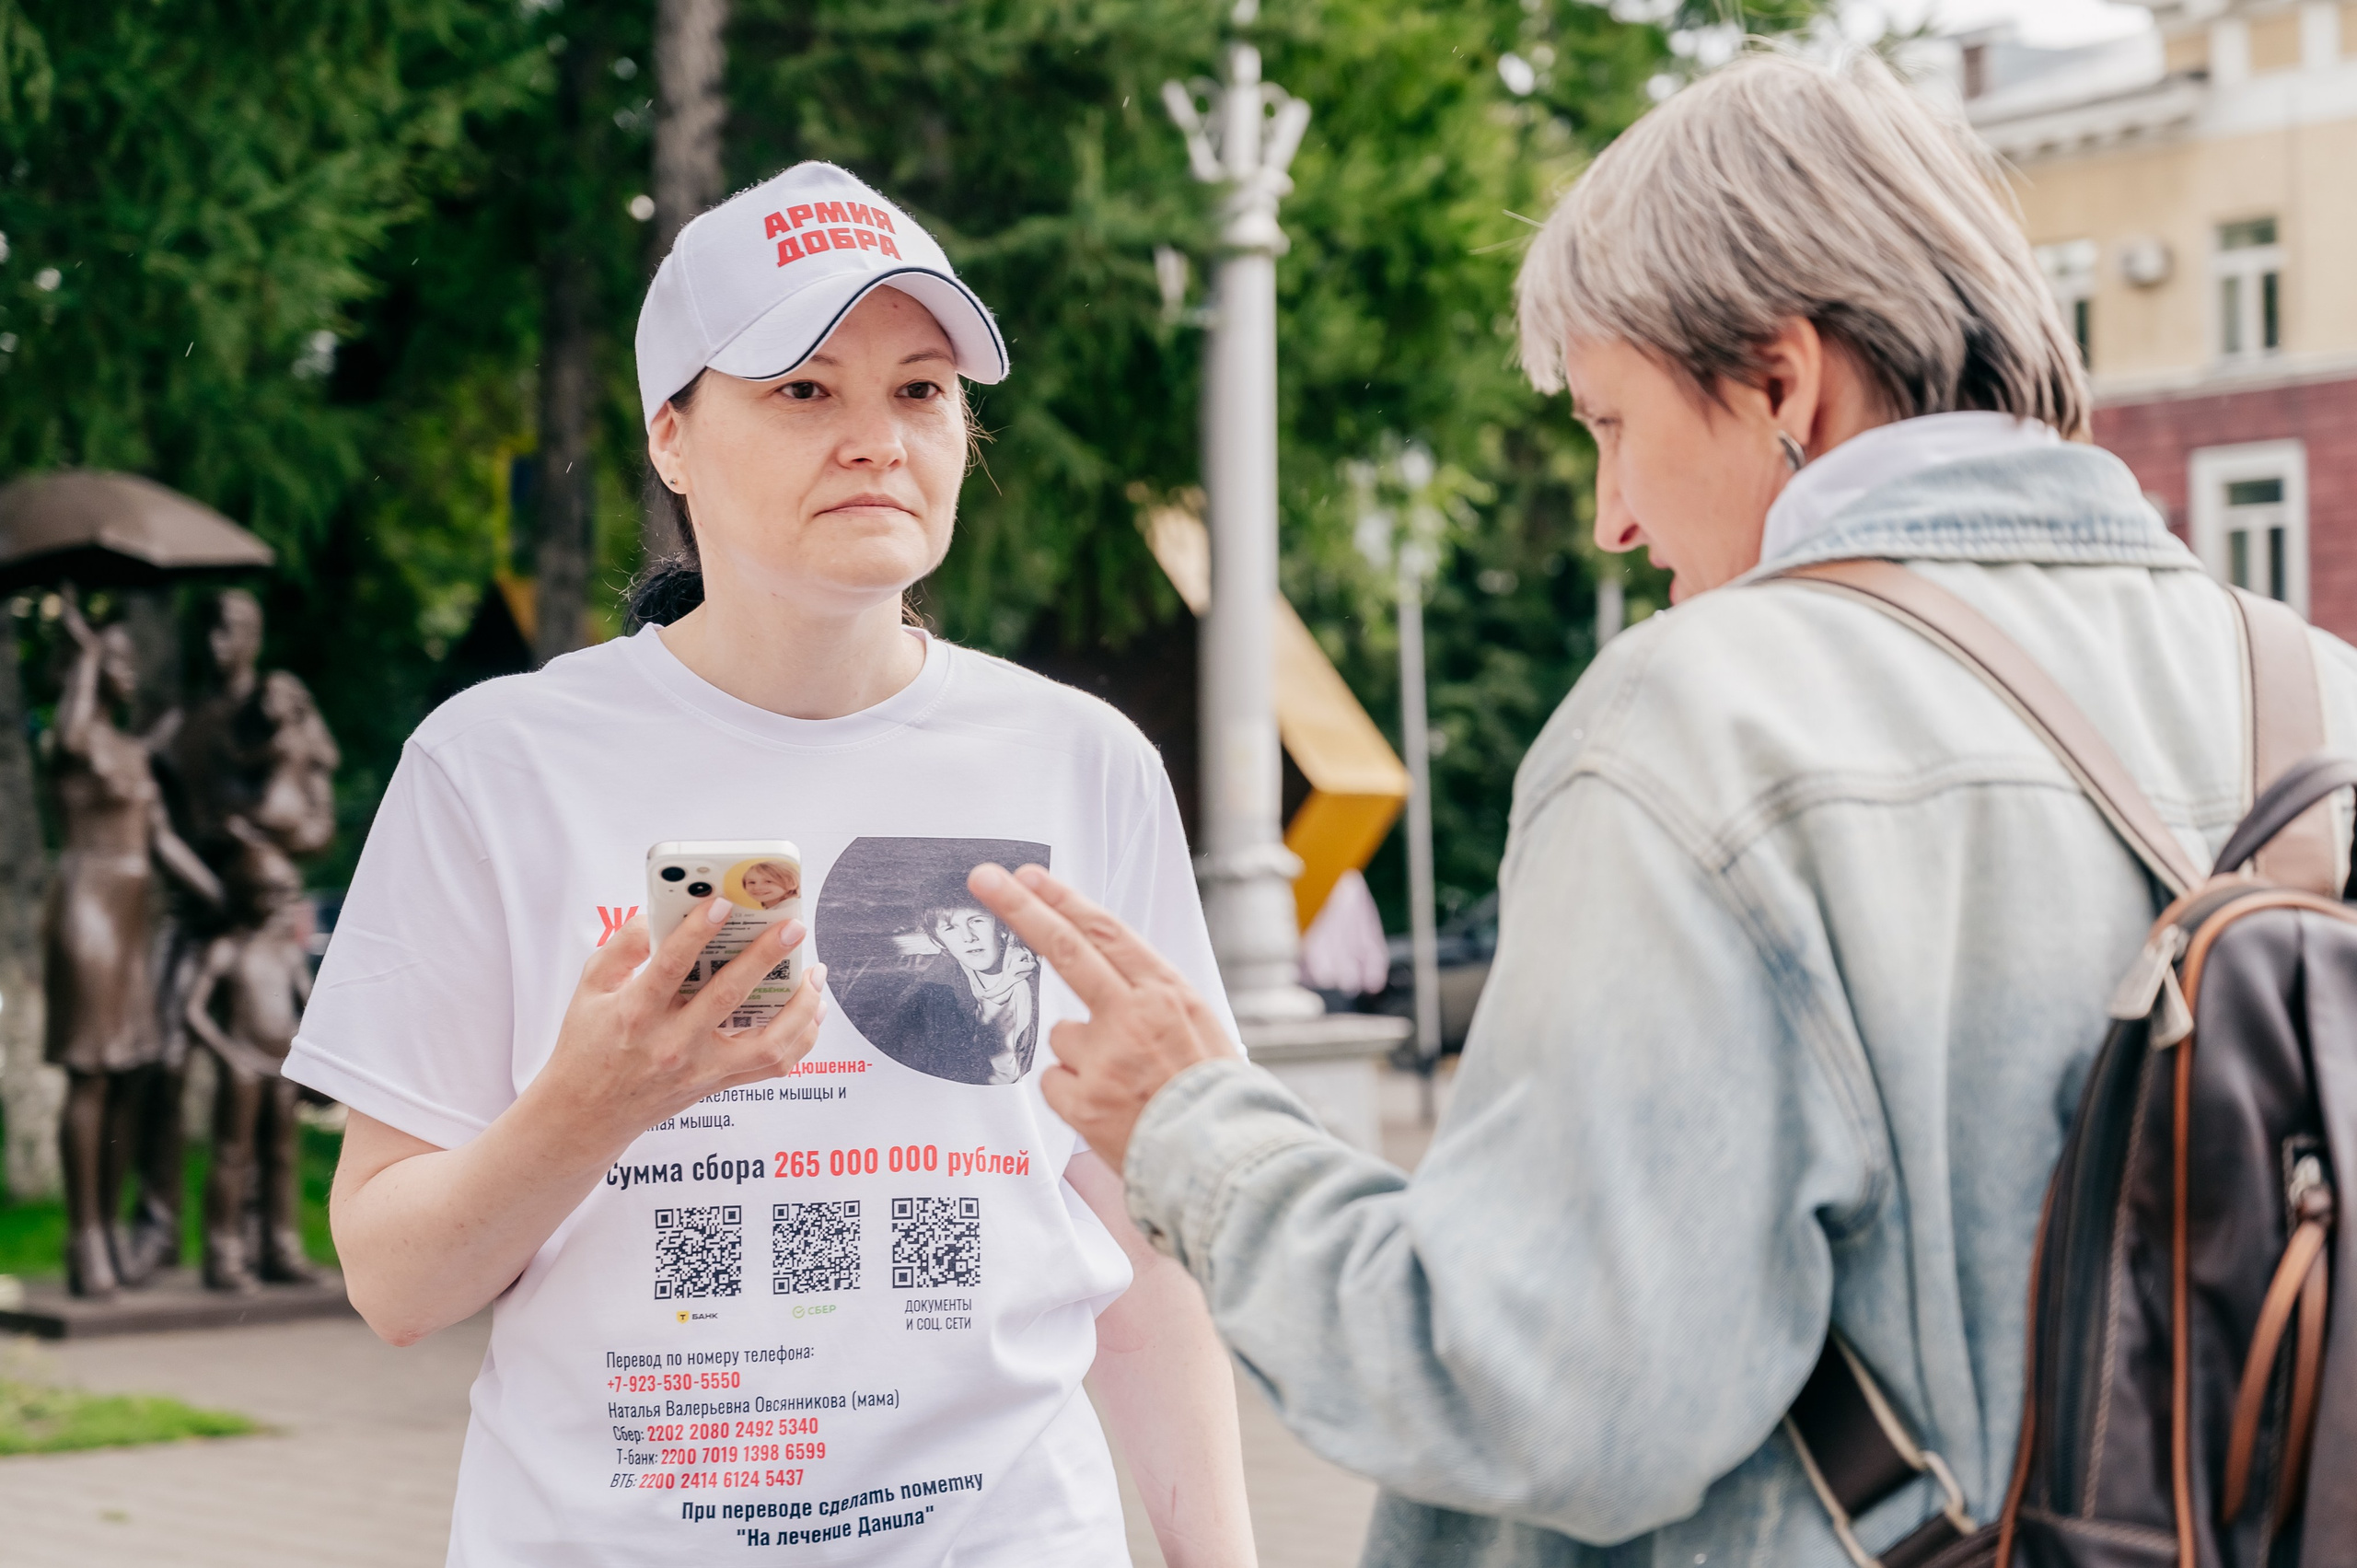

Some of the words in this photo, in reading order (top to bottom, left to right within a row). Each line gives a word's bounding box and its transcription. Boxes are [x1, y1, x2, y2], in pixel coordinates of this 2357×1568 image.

[764, 201, 897, 239] АРМИЯ
[777, 227, 902, 268] ДОБРА
[780, 1087, 832, 1102] мышцы
[839, 1087, 845, 1098] и
[680, 1115, 734, 1129] мышца.
[607, 1162, 683, 1191] Сумма
[693, 1153, 764, 1184] сбора
[775, 1151, 819, 1178] 265
[830, 1148, 877, 1176] 000
[889, 1145, 937, 1172] 000
[948, 1146, 1028, 1177] рублей
[808, 1305, 836, 1315] СБЕР
[905, 1299, 971, 1313] ДОКУМЕНТЫ
[907, 1318, 912, 1330] И
[917, 1318, 942, 1330] СОЦ.
[946, 1318, 970, 1330] СЕТИ
[606, 1352, 661, 1370] Перевод
[668, 1353, 681, 1365] по
[688, 1352, 738, 1366] номеру
[745, 1345, 815, 1365] телефона:
[608, 1371, 740, 1393] +7-923-530-5550
[609, 1402, 660, 1418] Наталья
[667, 1400, 749, 1418] Валерьевна
[756, 1396, 845, 1412] Овсянникова
[853, 1389, 899, 1410] (мама)
[613, 1426, 644, 1445] Сбер:
[647, 1424, 683, 1441] 2202
[690, 1423, 729, 1439] 2080
[736, 1421, 773, 1437] 2492
[780, 1418, 818, 1435] 5340
[617, 1448, 657, 1465] Т-банк:
[662, 1448, 696, 1464] 2200
[702, 1446, 737, 1463] 7019
[744, 1445, 779, 1461] 1398
[786, 1443, 825, 1459] 6599
[610, 1473, 637, 1488] ВТБ:
[639, 1473, 675, 1489] 2200
[680, 1472, 717, 1488] 2414
[724, 1470, 760, 1487] 6124
[766, 1469, 803, 1486] 5437
[681, 1502, 716, 1520] При
[723, 1503, 811, 1521] переводе
[819, 1488, 896, 1519] сделать
[900, 1474, 981, 1499] пометку
[737, 1529, 770, 1546] "На
[777, 1523, 851, 1545] лечение
[857, 1504, 935, 1538] Данила"
